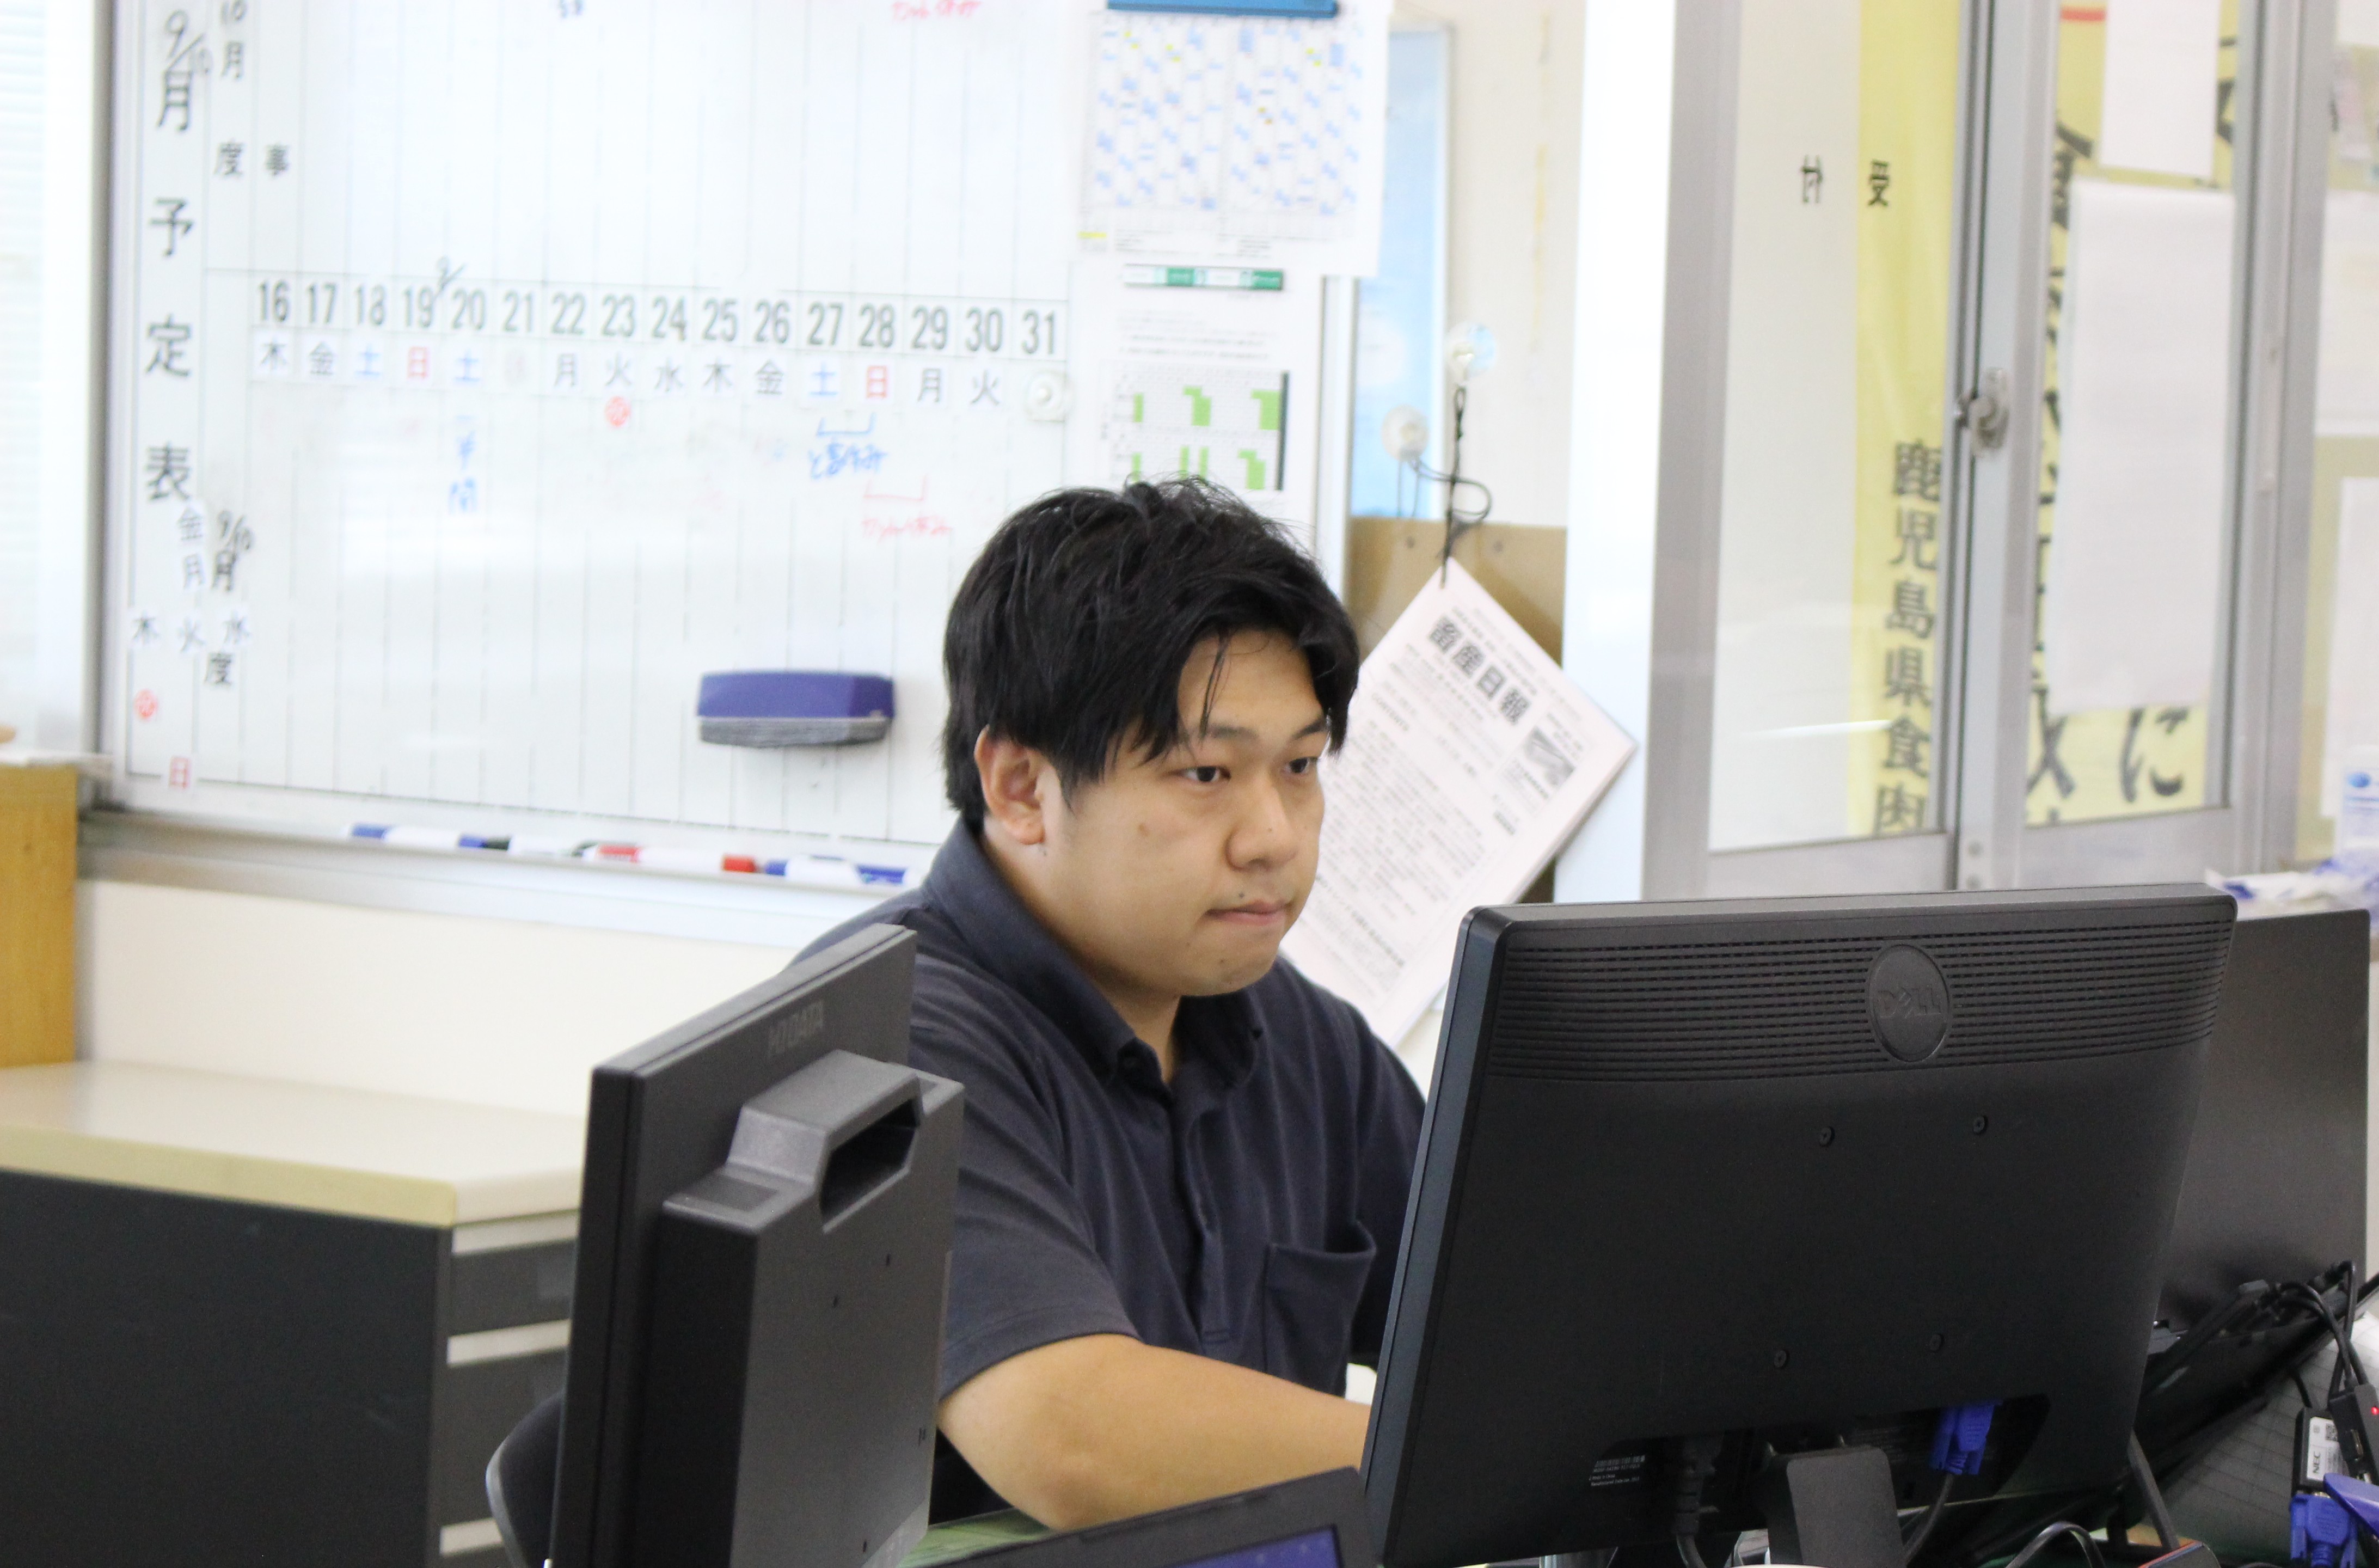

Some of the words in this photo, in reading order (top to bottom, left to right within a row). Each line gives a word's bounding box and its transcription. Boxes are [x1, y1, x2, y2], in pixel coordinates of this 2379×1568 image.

[258, 278, 292, 323] 16
[306, 281, 338, 325] 17
[353, 283, 387, 327] 18
[403, 284, 435, 329] 19
[451, 288, 486, 330] 20
[502, 290, 535, 333] 21
[551, 291, 586, 335] 22
[601, 292, 637, 338] 23
[652, 295, 688, 343] 24
[702, 297, 738, 343] 25
[753, 299, 790, 344] 26
[806, 301, 844, 346] 27
[858, 303, 896, 349] 28
[911, 305, 949, 351] 29
[965, 306, 1003, 353] 30
[1022, 308, 1057, 355] 31
[260, 340, 288, 367] 木
[308, 341, 336, 376] 金
[354, 343, 382, 376] 土
[407, 346, 429, 379] 日
[452, 348, 483, 382] 土
[553, 352, 579, 387] 月
[604, 351, 632, 387] 火
[654, 357, 684, 393] 水
[703, 357, 733, 393] 木
[754, 359, 784, 396] 金
[810, 362, 839, 397] 土
[864, 364, 890, 400] 日
[916, 367, 943, 404] 月
[969, 369, 1001, 407] 火
[177, 506, 204, 541] 金
[182, 553, 205, 590] 月
[132, 609, 160, 645] 木
[177, 616, 206, 653] 火
[222, 609, 251, 645] 水
[1873, 438, 1942, 835] 鹿児島県食肉
[1426, 614, 1533, 726] 畜産日報
[168, 756, 192, 789] 日
[2312, 1451, 2321, 1473] NEC
